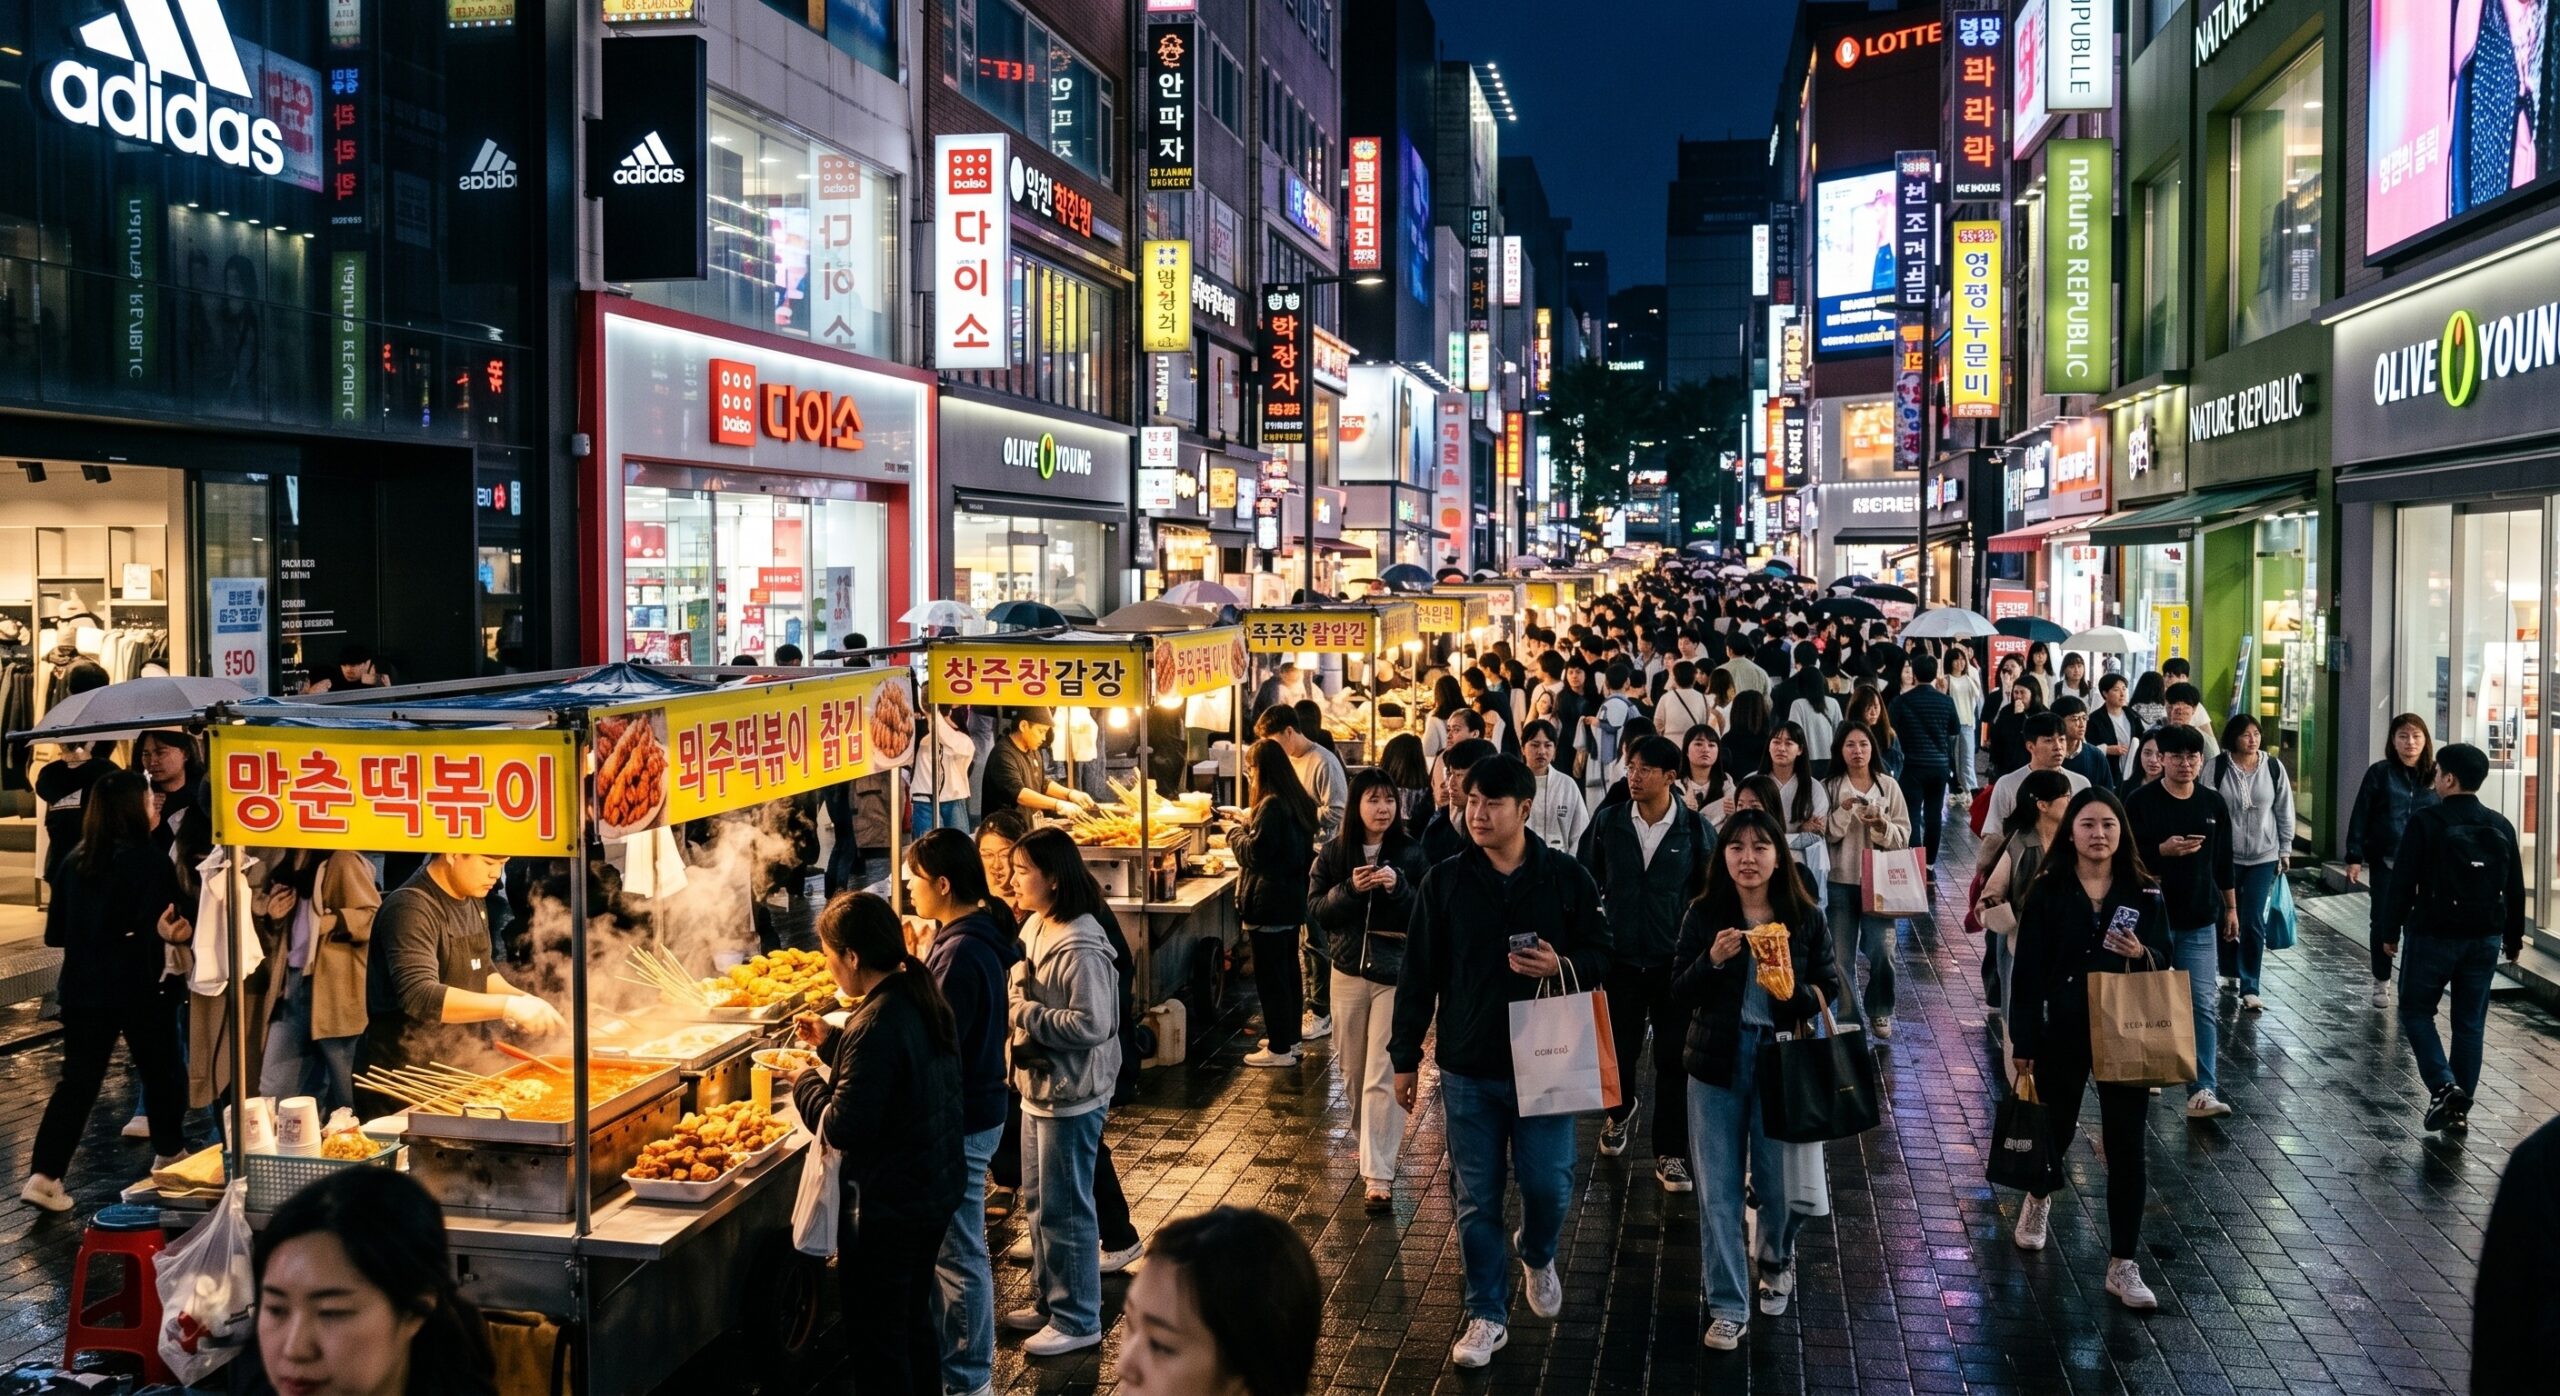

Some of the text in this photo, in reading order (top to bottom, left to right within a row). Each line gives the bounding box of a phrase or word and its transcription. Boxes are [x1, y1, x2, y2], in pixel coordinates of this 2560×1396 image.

[1865, 22, 1942, 57] LOTTE
[50, 60, 284, 175] adidas
[613, 164, 685, 184] adidas
[954, 210, 992, 348] 다이소
[2065, 158, 2094, 378] nature REPUBLIC
[2374, 302, 2560, 406] OLIVE YOUN
[722, 415, 752, 434] Daiso
[761, 383, 864, 450] 다이소
[2190, 373, 2303, 443] NATURE REPUBLIC
[1003, 437, 1092, 476] OLIVE YOUNG
[227, 748, 556, 840] 망춘떡볶이
